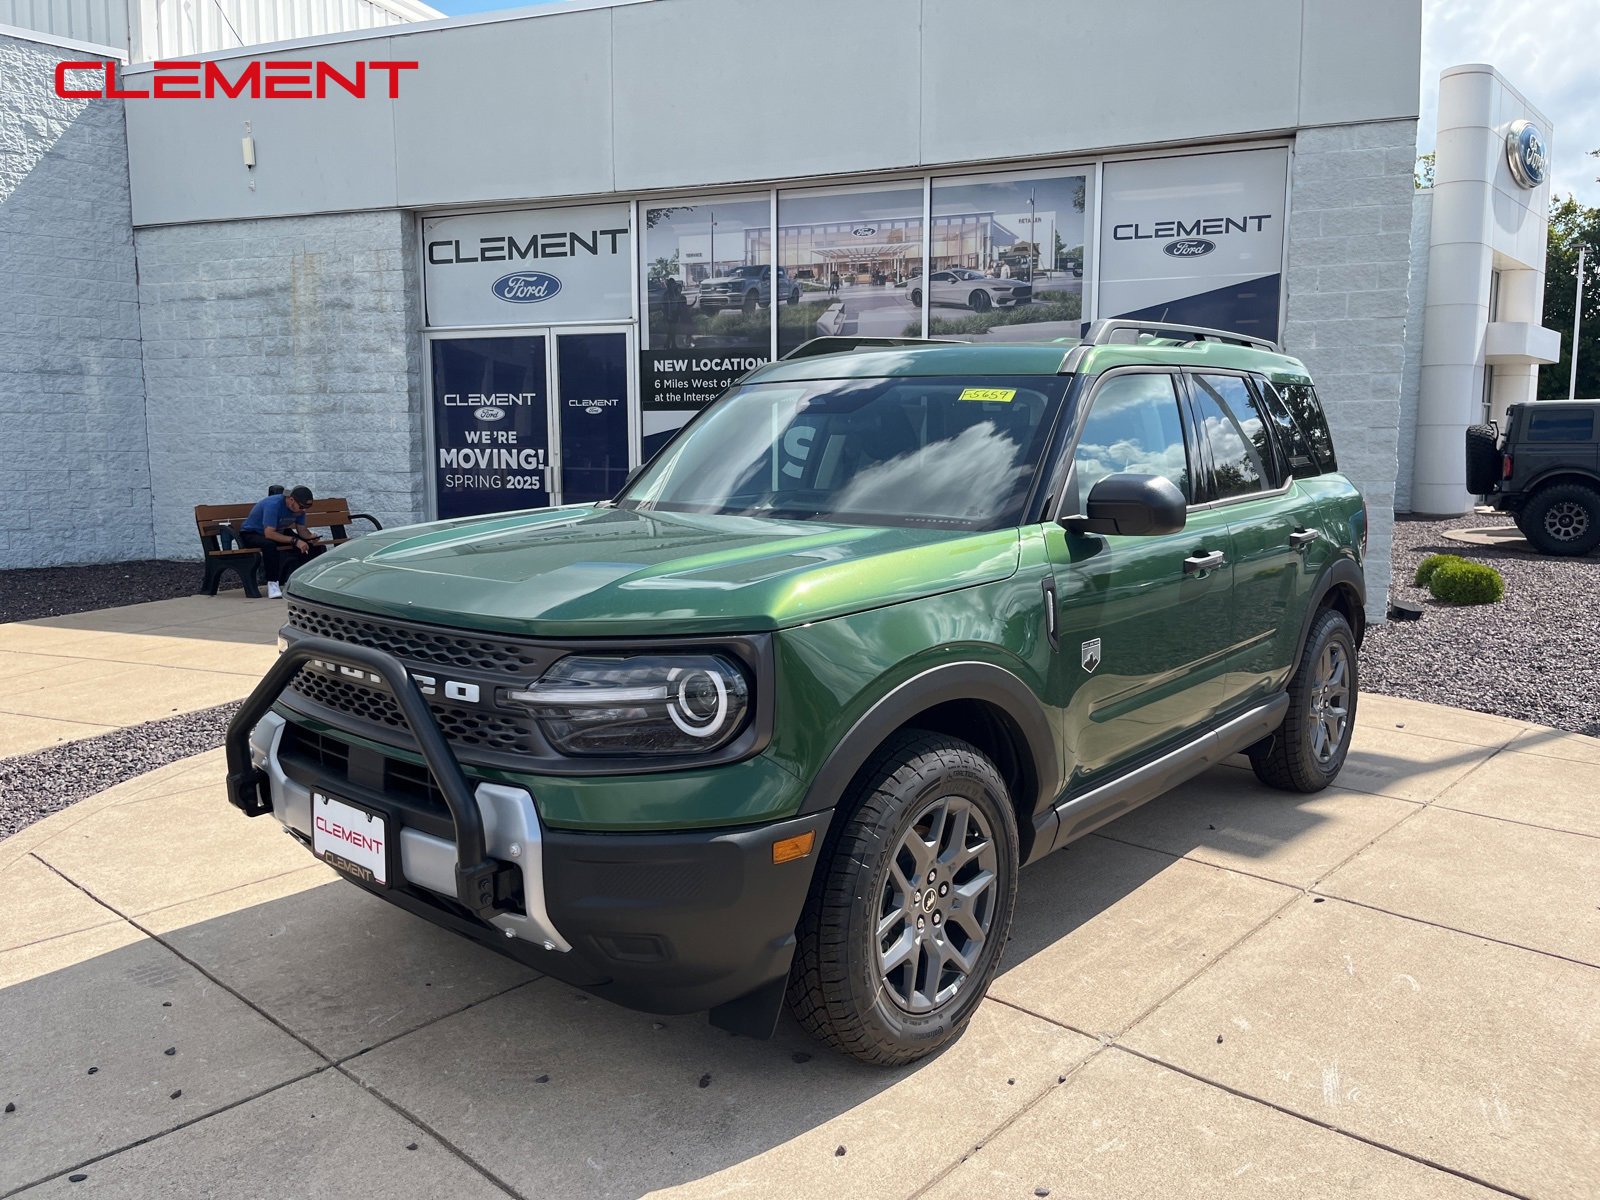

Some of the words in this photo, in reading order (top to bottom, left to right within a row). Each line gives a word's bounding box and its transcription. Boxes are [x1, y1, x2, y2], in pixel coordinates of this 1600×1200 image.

[1113, 214, 1272, 241] CLEMENT
[428, 228, 629, 265] CLEMENT
[1173, 241, 1207, 255] Ford
[504, 276, 549, 298] Ford
[653, 359, 688, 372] NEW
[654, 379, 661, 389] 6
[664, 378, 689, 389] Miles
[691, 378, 718, 388] West
[720, 377, 732, 388] of
[444, 393, 536, 406] CLEMENT
[568, 399, 619, 407] CLEMENT
[654, 393, 664, 402] at
[666, 392, 681, 402] the
[465, 431, 517, 444] WE'RE
[440, 448, 545, 470] MOVING!
[445, 474, 501, 489] SPRING
[506, 475, 540, 490] 2025
[316, 816, 383, 855] CLEMENT
[325, 852, 372, 881] CLEMENT
